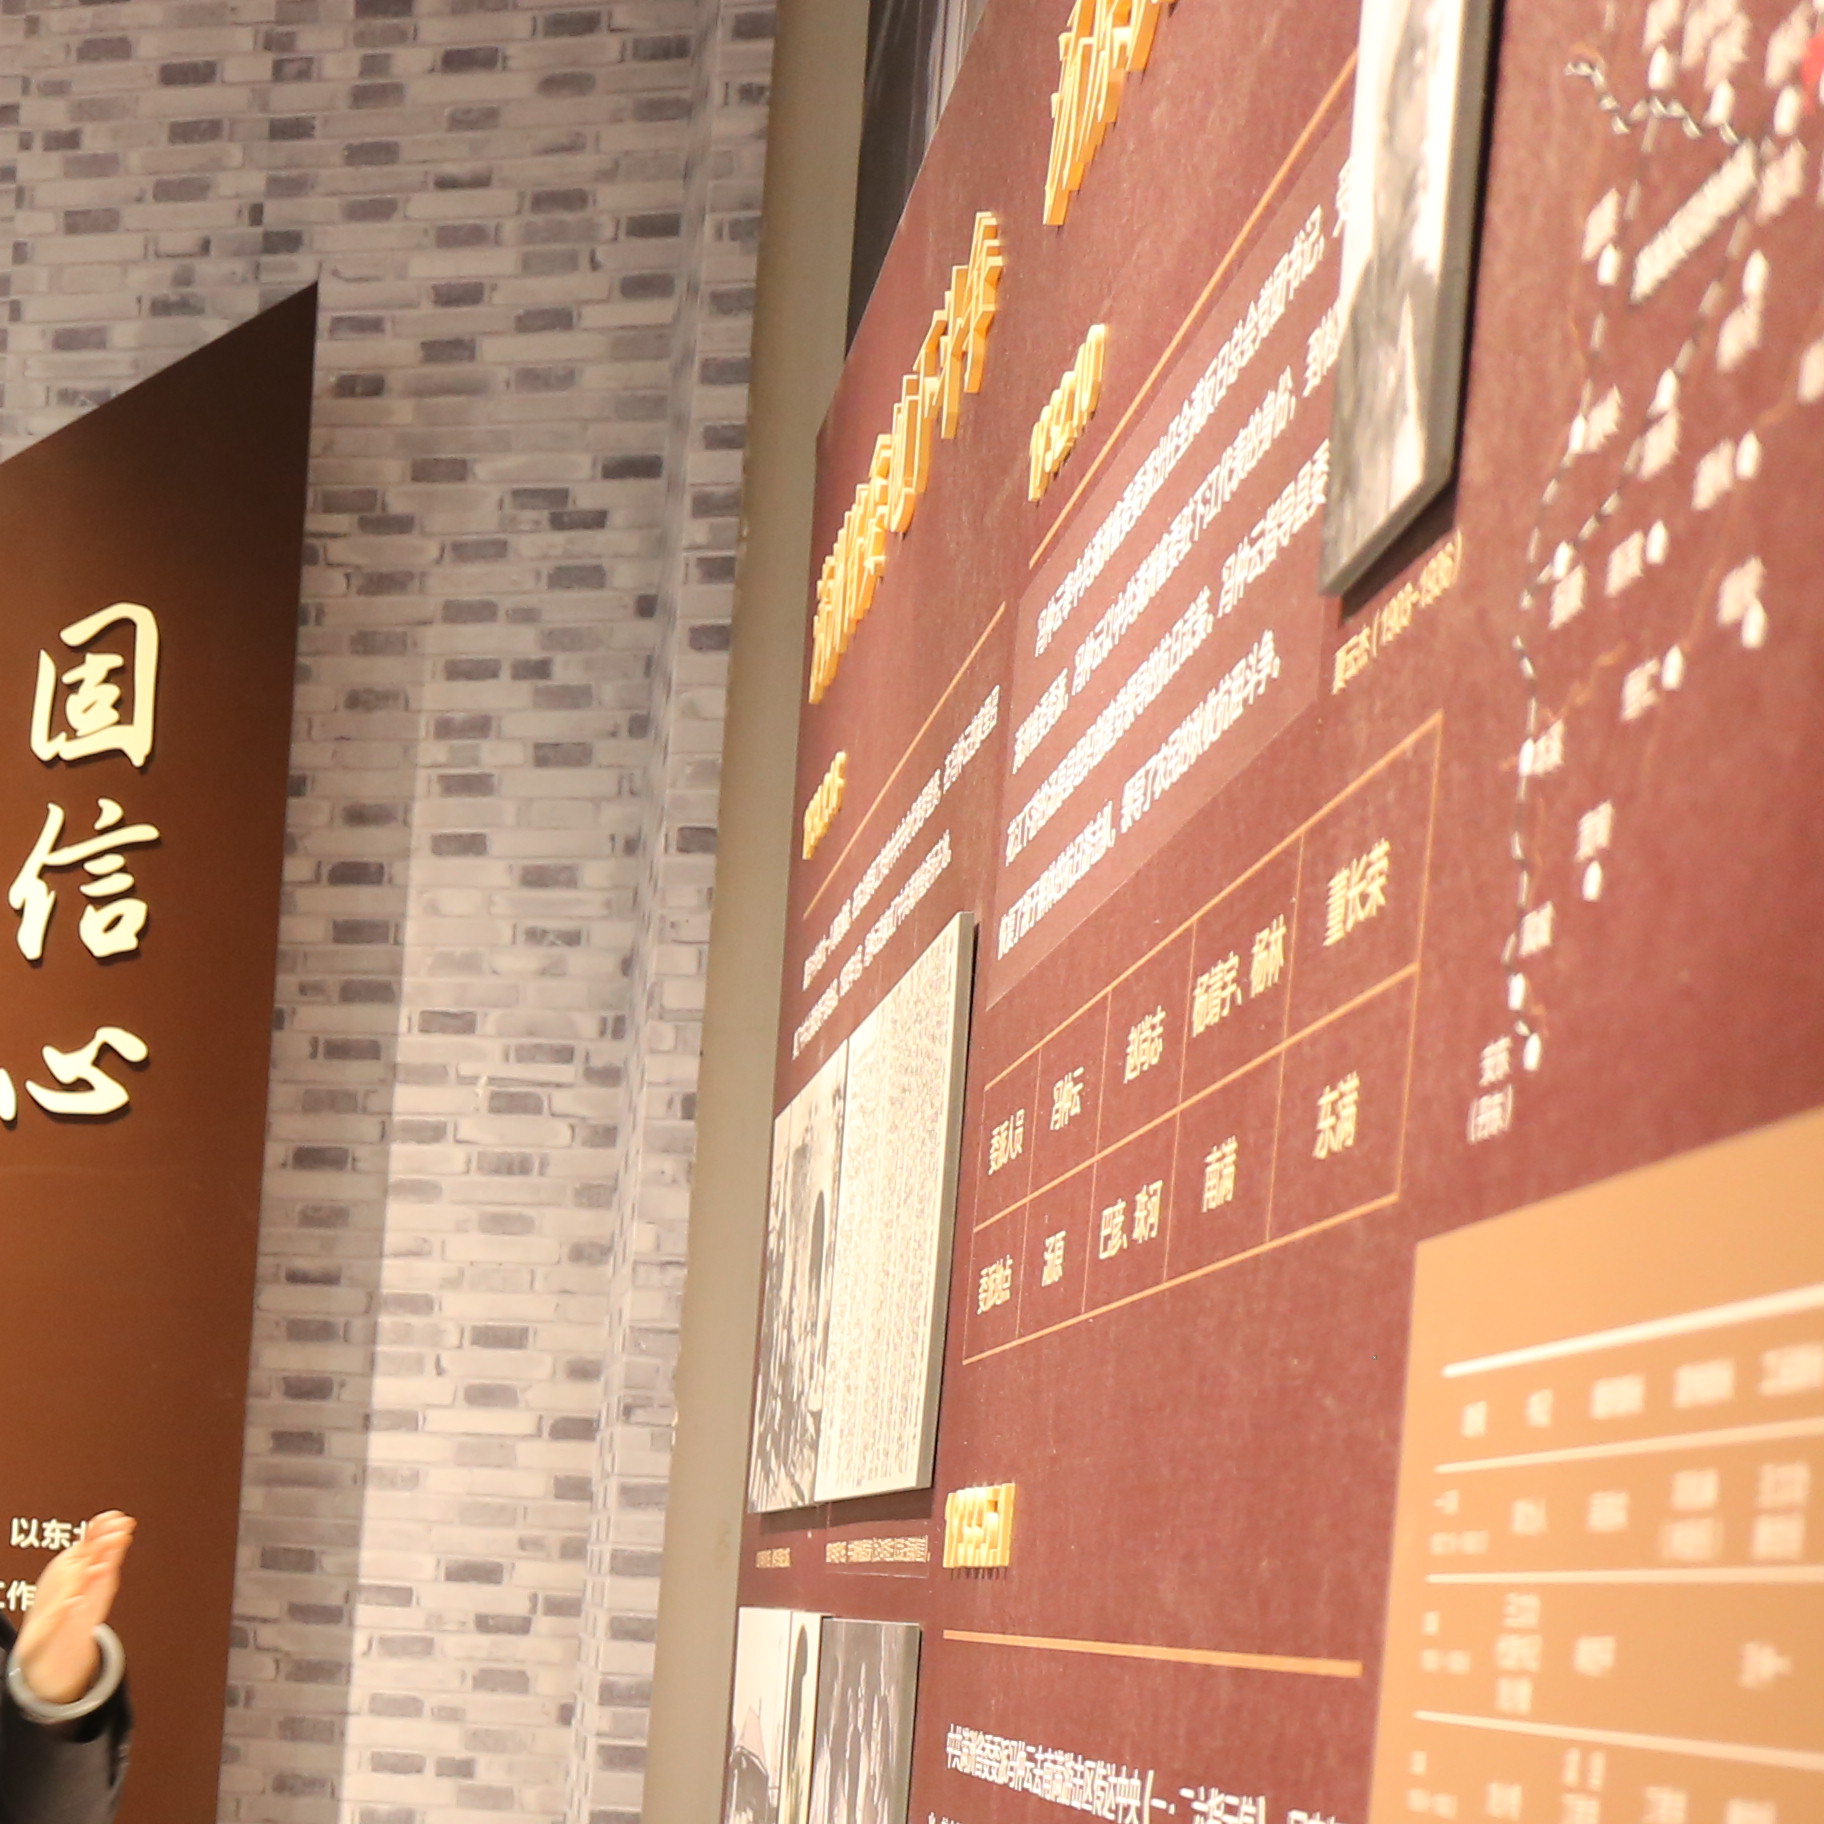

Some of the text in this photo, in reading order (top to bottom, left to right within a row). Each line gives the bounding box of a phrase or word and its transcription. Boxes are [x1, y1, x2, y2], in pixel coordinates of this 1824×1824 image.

[1323, 838, 1391, 948] 董长荣
[1191, 909, 1287, 1039] 杨靖宇、杨林
[1124, 1006, 1164, 1084] 赵尚志
[1049, 1068, 1084, 1131] 冯仲云
[1313, 1071, 1360, 1160] 东满
[1202, 1137, 1238, 1214] 南满
